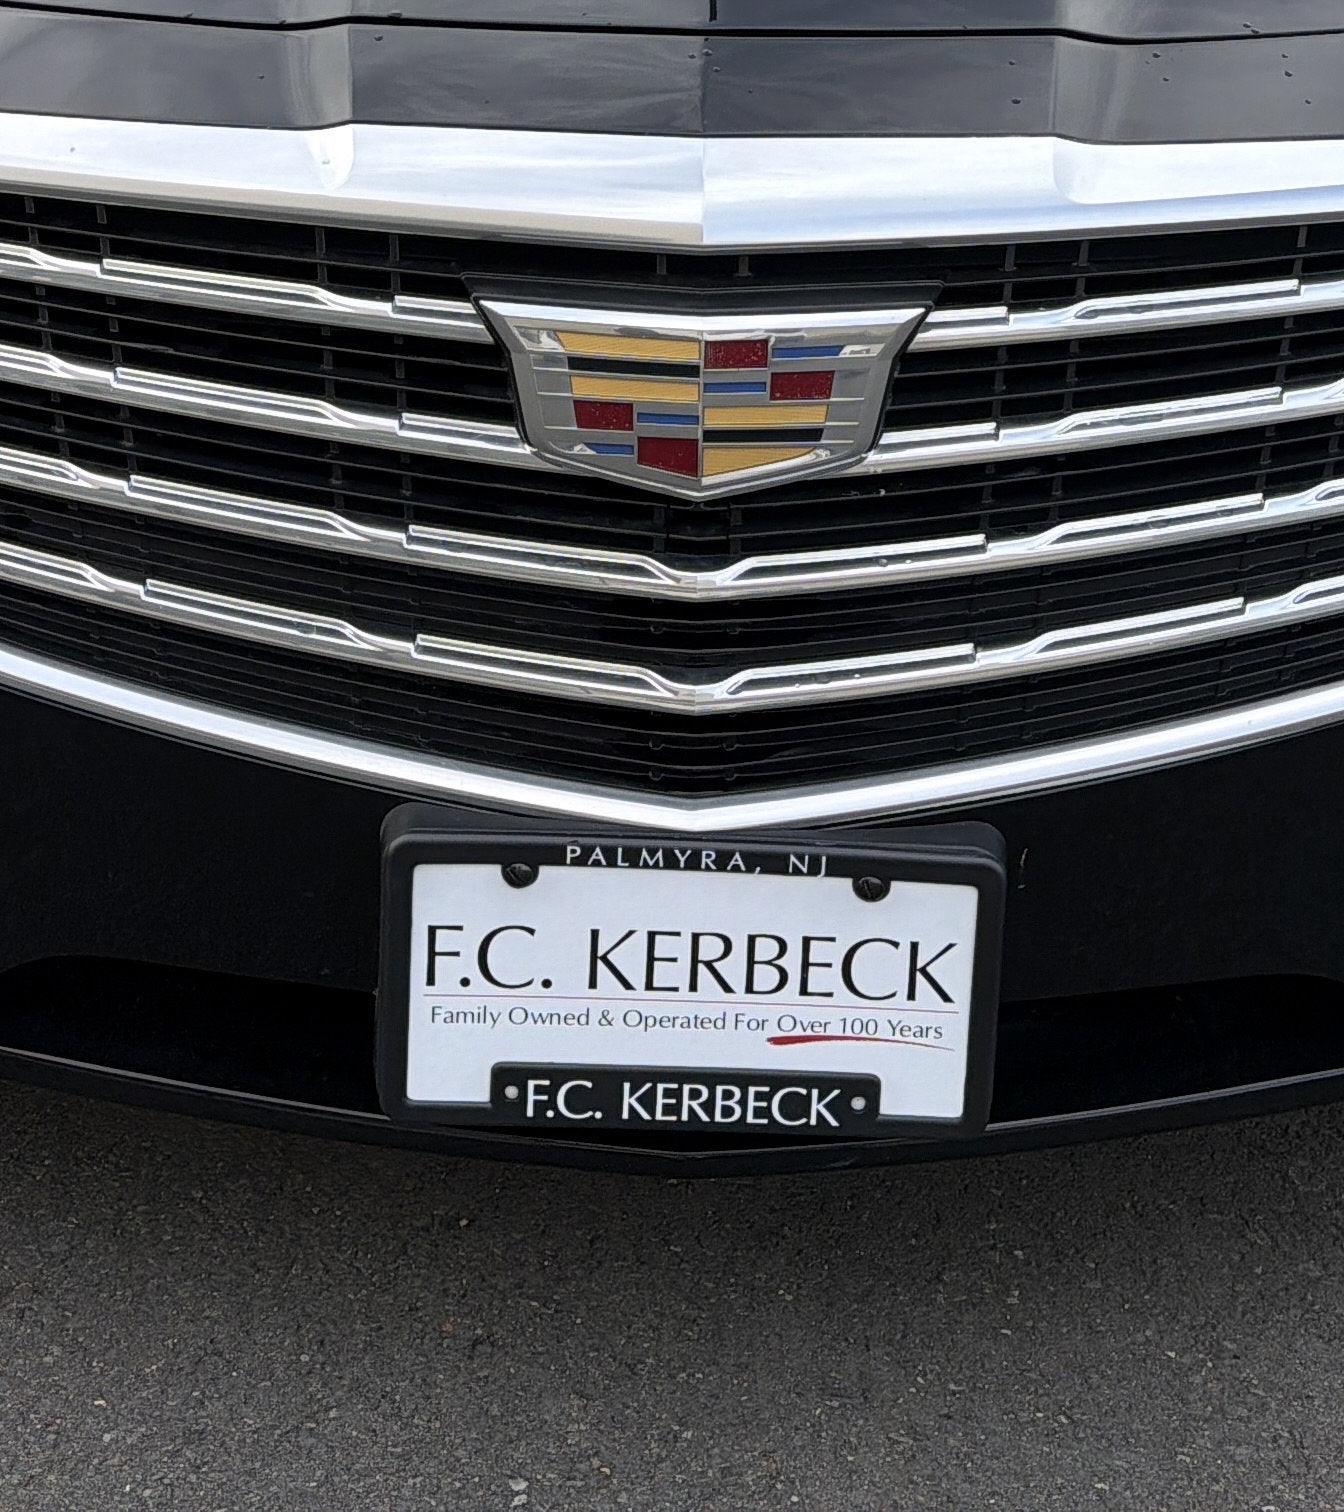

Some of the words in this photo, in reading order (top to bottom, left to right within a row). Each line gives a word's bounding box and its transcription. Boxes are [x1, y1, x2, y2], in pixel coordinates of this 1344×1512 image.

[565, 844, 763, 875] PALMYRA,
[788, 855, 829, 880] NJ
[424, 923, 553, 990] F.C.
[587, 928, 959, 1005] KERBECK
[430, 1005, 502, 1029] Family
[508, 1007, 591, 1028] Owned
[597, 1009, 615, 1029] &
[623, 1010, 727, 1033] Operated
[734, 1014, 770, 1033] For
[777, 1015, 830, 1036] Over
[839, 1018, 879, 1037] 100
[887, 1020, 944, 1041] Years
[526, 1079, 603, 1120] F.C.
[621, 1082, 842, 1127] KERBECK
